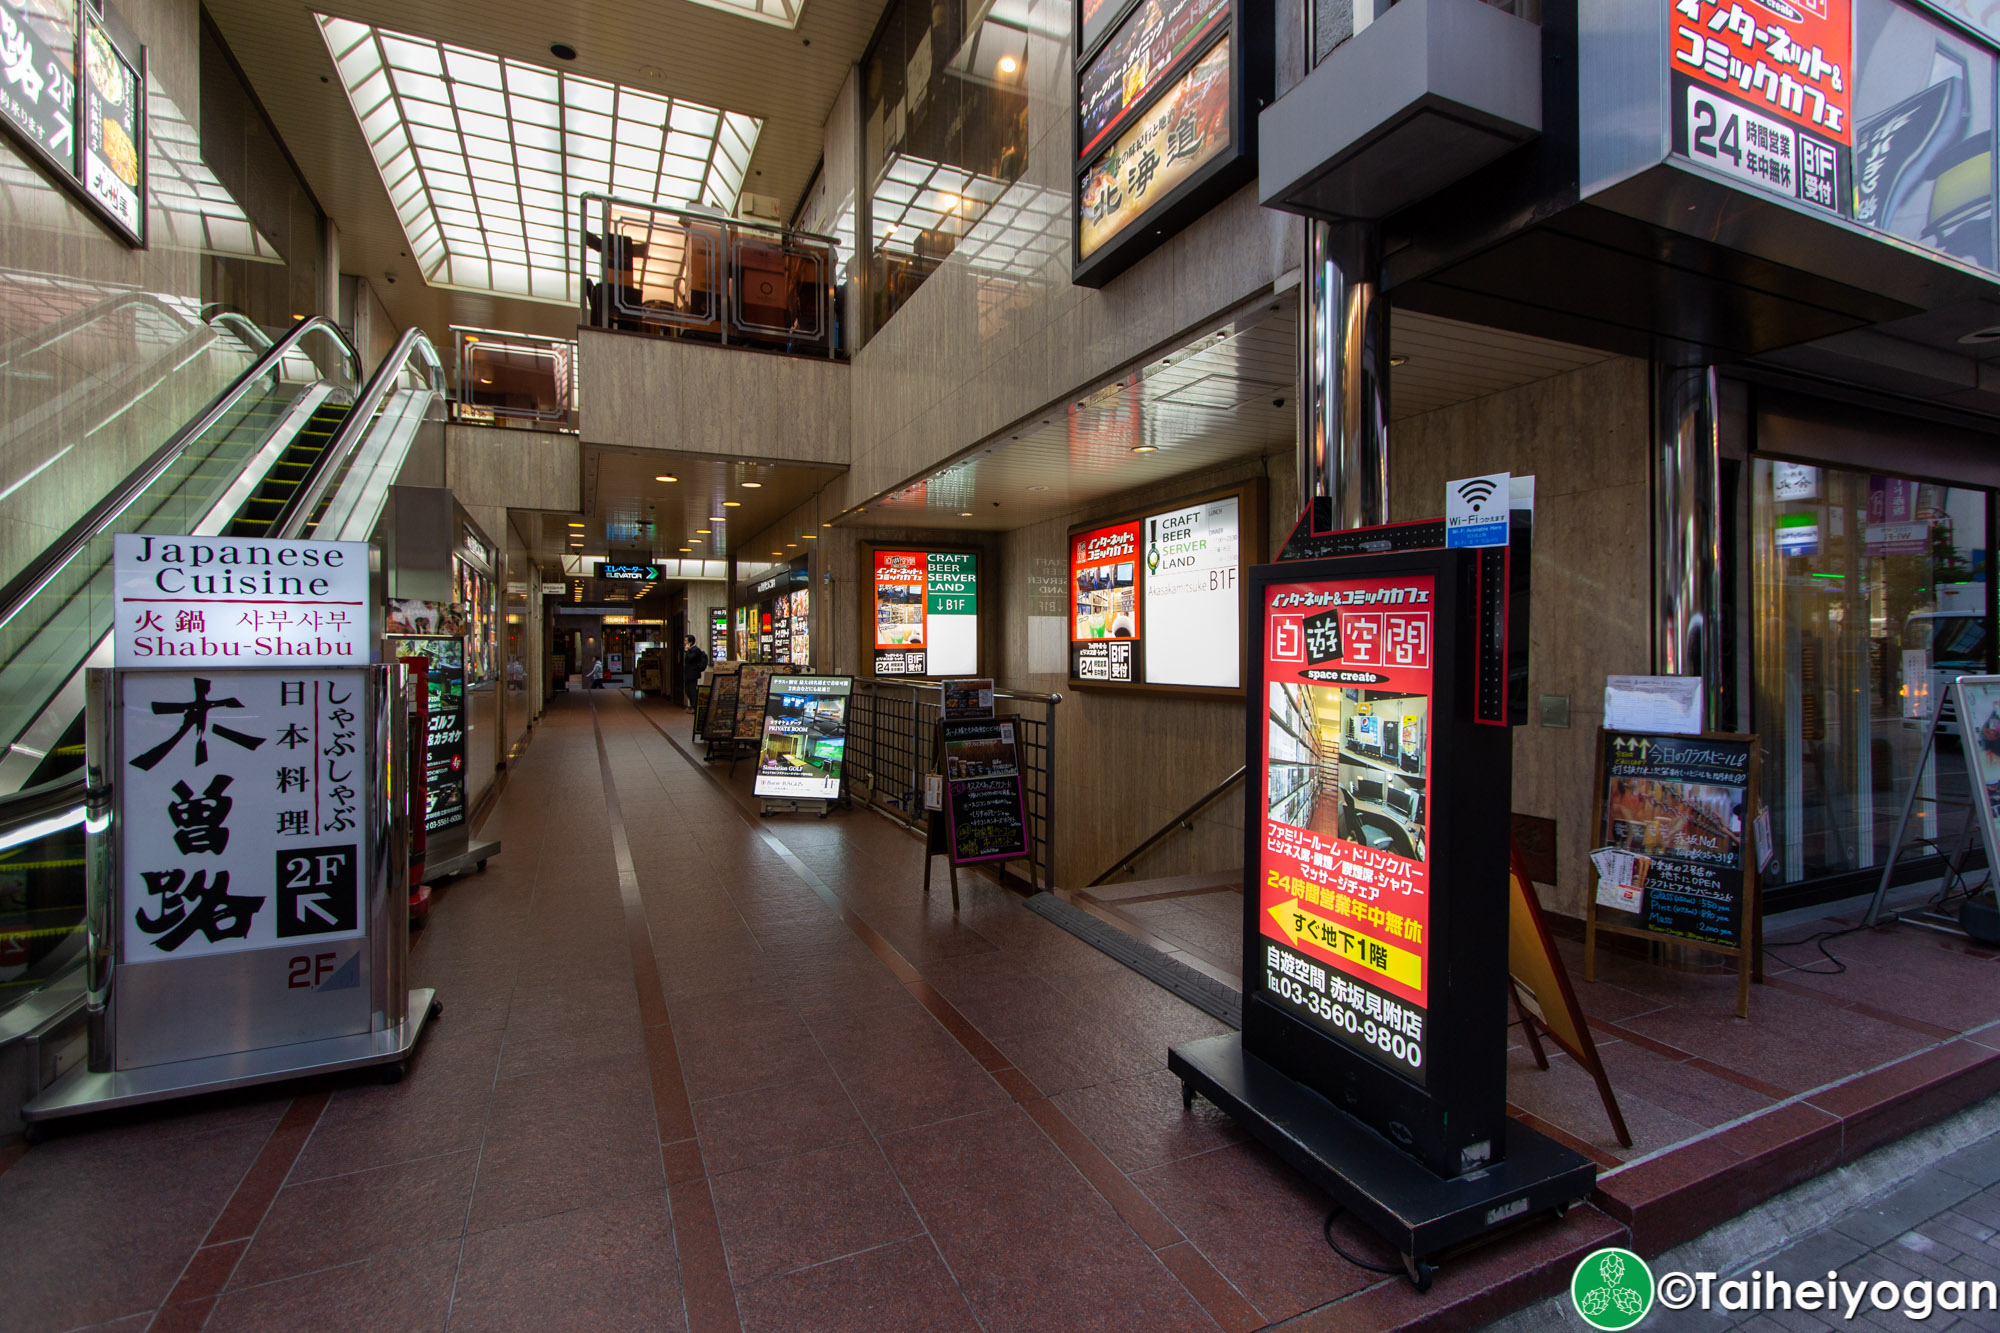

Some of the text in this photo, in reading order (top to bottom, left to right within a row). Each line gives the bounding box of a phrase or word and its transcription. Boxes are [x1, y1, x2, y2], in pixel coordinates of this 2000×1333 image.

[46, 61, 75, 113] 2F
[1676, 26, 1843, 132] コミックカフェ
[1114, 108, 1176, 171] 北の味紀行と地酒
[1693, 100, 1742, 168] 24
[1746, 120, 1790, 160] 時間営業
[1093, 110, 1205, 227] 北海道
[1746, 150, 1791, 188] 年中無休
[1803, 142, 1833, 177] B1F
[1804, 177, 1832, 205] 受付
[1162, 512, 1200, 529] CRAFT
[1449, 514, 1505, 526] Wi-Fi つかえます
[1088, 531, 1135, 550] インターネット&
[1163, 528, 1191, 543] BEER
[136, 537, 344, 568] Japanese
[927, 554, 969, 563] CRAFT
[1087, 544, 1134, 561] コミックカフェ
[1162, 539, 1207, 556] SERVER
[604, 565, 644, 573] エレベーター
[928, 564, 960, 572] BEER
[1163, 556, 1195, 570] LAND
[155, 568, 329, 597] Cuisine
[927, 573, 976, 582] SERVER
[928, 583, 965, 591] LAND
[1209, 568, 1236, 591] B1F
[946, 599, 965, 610] B1F
[1271, 587, 1430, 608] インターネット&コミックカフェ
[134, 608, 205, 634] 火鍋
[237, 608, 352, 633] 샤부샤부
[133, 635, 353, 657] Shabu-Shabu
[1276, 617, 1425, 664] 自遊空間
[908, 655, 923, 664] B1F
[1111, 645, 1128, 662] B1F
[877, 663, 890, 673] 24
[908, 664, 922, 672] 受付
[1081, 660, 1093, 676] 24
[1111, 664, 1128, 678] 受付
[1308, 670, 1377, 683] space create
[276, 680, 310, 837] 日本料理
[324, 680, 357, 834] しゃぶしゃぶ
[762, 764, 788, 772] Simulation
[128, 676, 268, 953] 木曽路
[1268, 823, 1424, 877] ファミリールーム・ドリンクバー
[286, 853, 345, 888] 2F
[1300, 864, 1380, 901] マッサージチェア
[1267, 869, 1423, 944] 24時間営業年中無休
[1649, 889, 1674, 901] Glass
[1650, 900, 1673, 912] Pint
[1293, 912, 1387, 971] すぐ地下1階
[288, 953, 336, 989] 2F
[1267, 945, 1422, 1042] 自遊空間 赤坂見附店
[1267, 969, 1421, 1068] TEL 03-3560-9800
